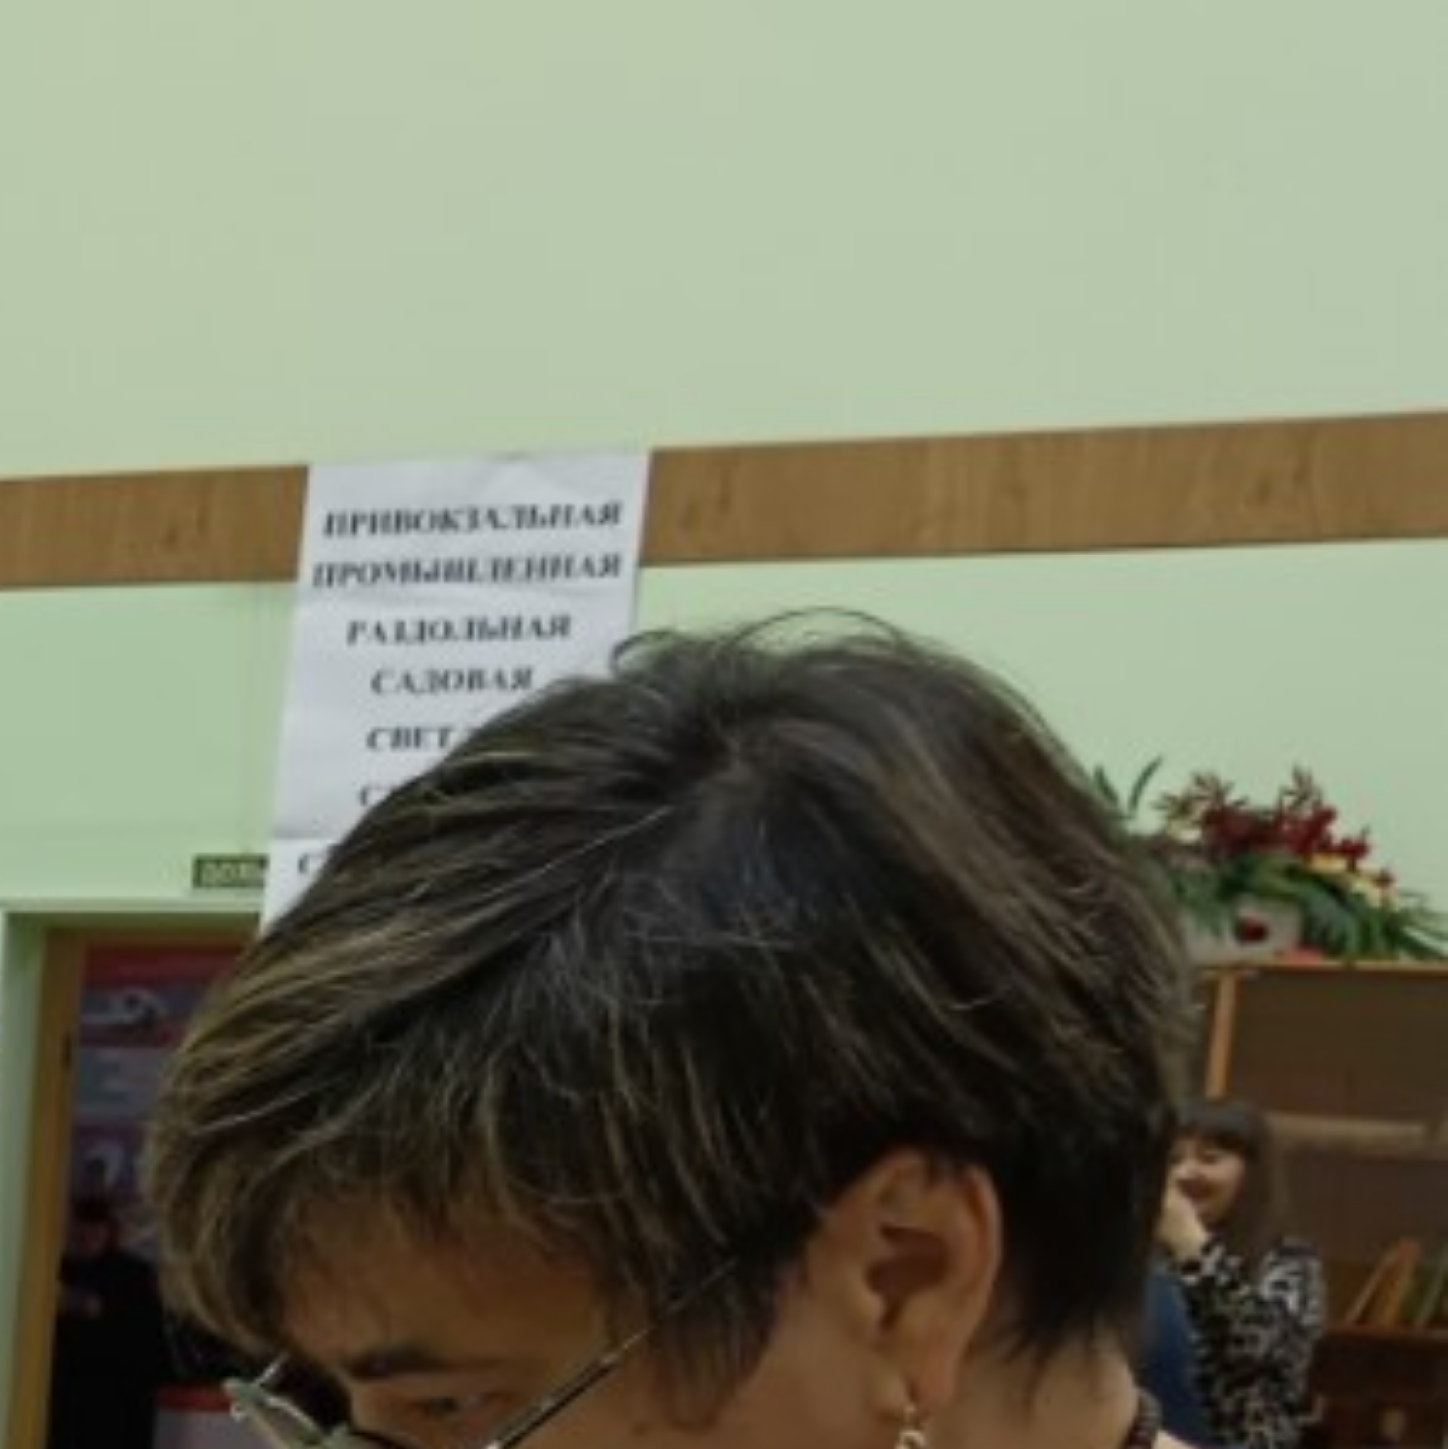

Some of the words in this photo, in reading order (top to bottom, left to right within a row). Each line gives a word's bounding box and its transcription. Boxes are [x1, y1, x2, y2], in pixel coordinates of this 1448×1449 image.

[323, 502, 623, 538] ПРИВОКЗАЛЬНАЯ
[312, 553, 622, 588] ПРОМЫШЛЕННАЯ
[370, 667, 532, 696] САДОВАЯ
